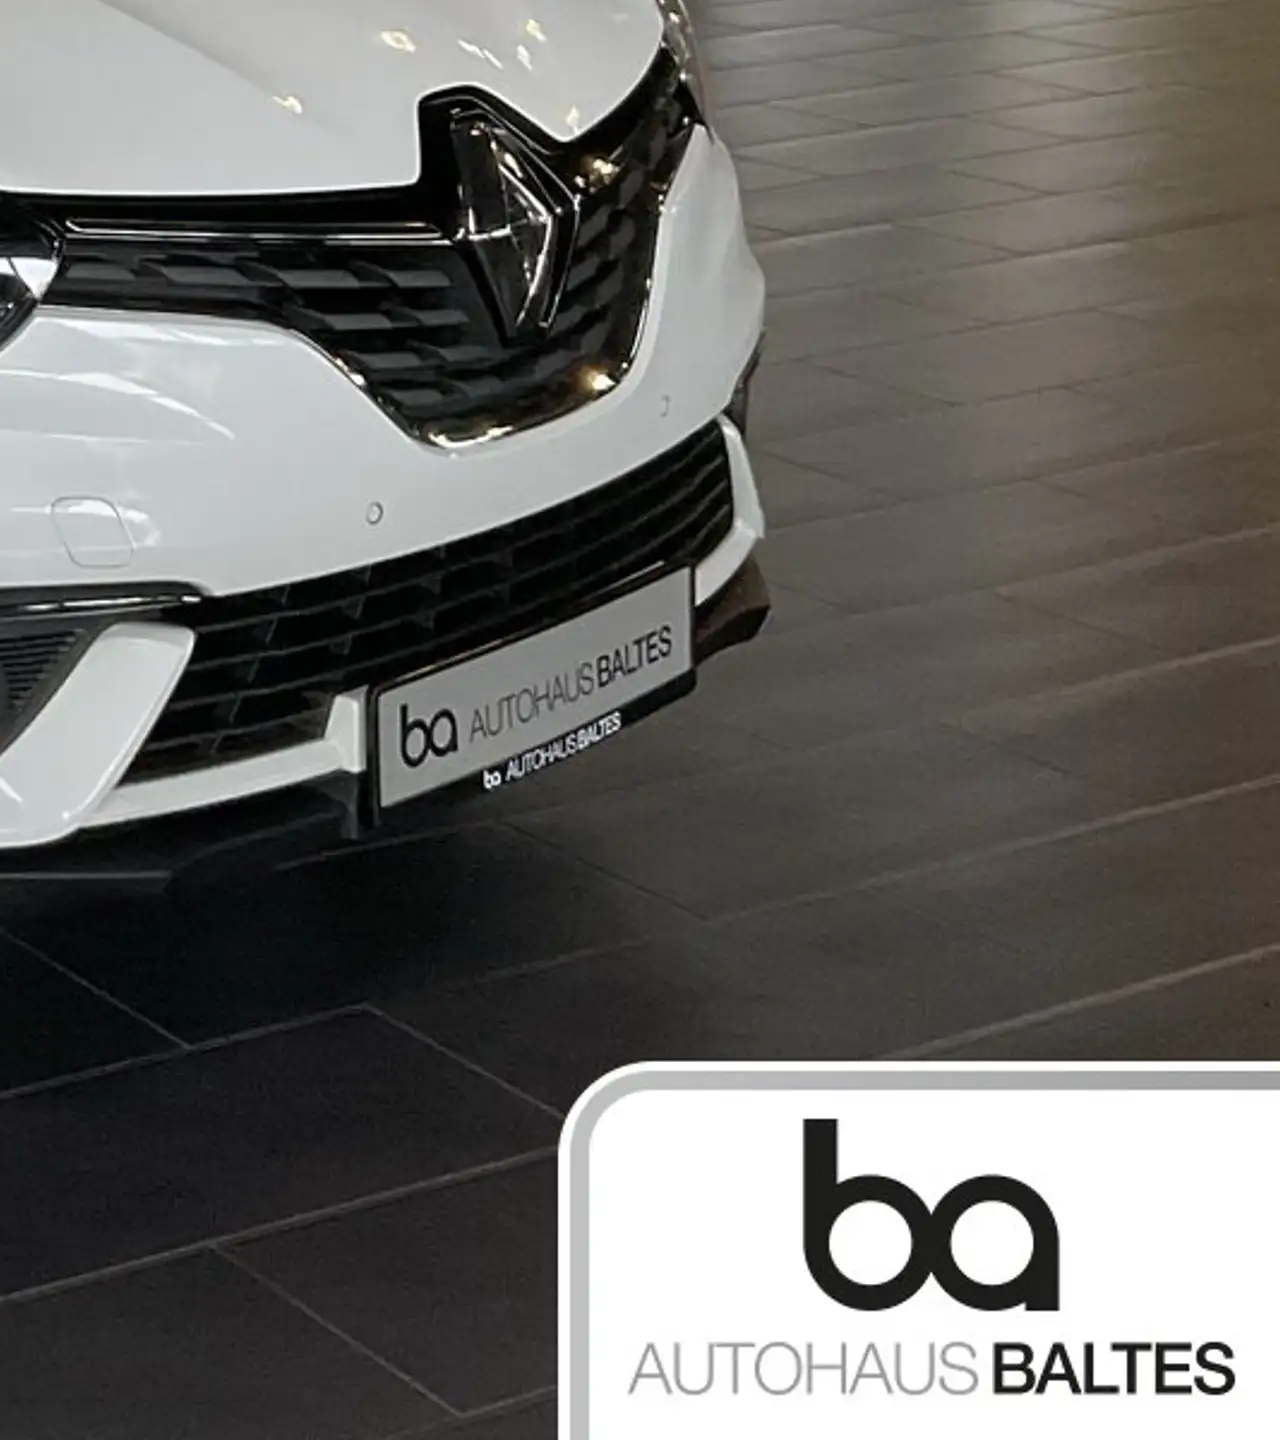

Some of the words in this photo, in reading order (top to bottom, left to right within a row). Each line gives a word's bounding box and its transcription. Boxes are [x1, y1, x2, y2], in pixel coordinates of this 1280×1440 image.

[400, 703, 458, 768] ba
[469, 663, 595, 742] AUTOHAUS
[596, 624, 672, 687] BALTES
[483, 770, 501, 790] ba
[505, 733, 577, 781] AUTOHAUS
[576, 711, 622, 751] BALTES
